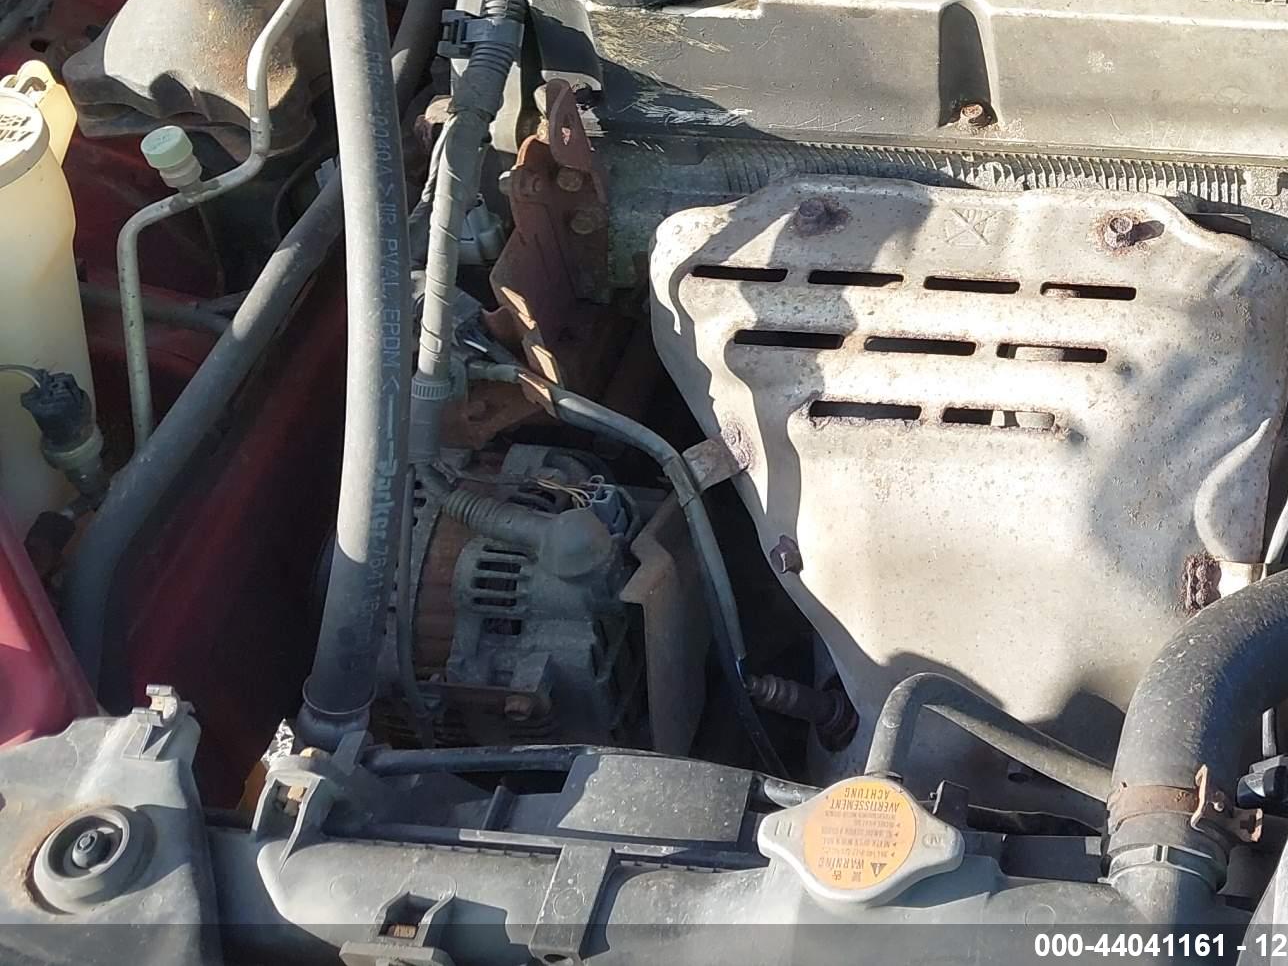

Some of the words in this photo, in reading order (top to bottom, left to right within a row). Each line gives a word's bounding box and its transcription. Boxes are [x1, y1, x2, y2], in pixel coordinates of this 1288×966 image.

[843, 786, 891, 801] ACHTUNG
[829, 799, 901, 814] AVERTISSEMENT
[817, 856, 865, 870] WARNING
